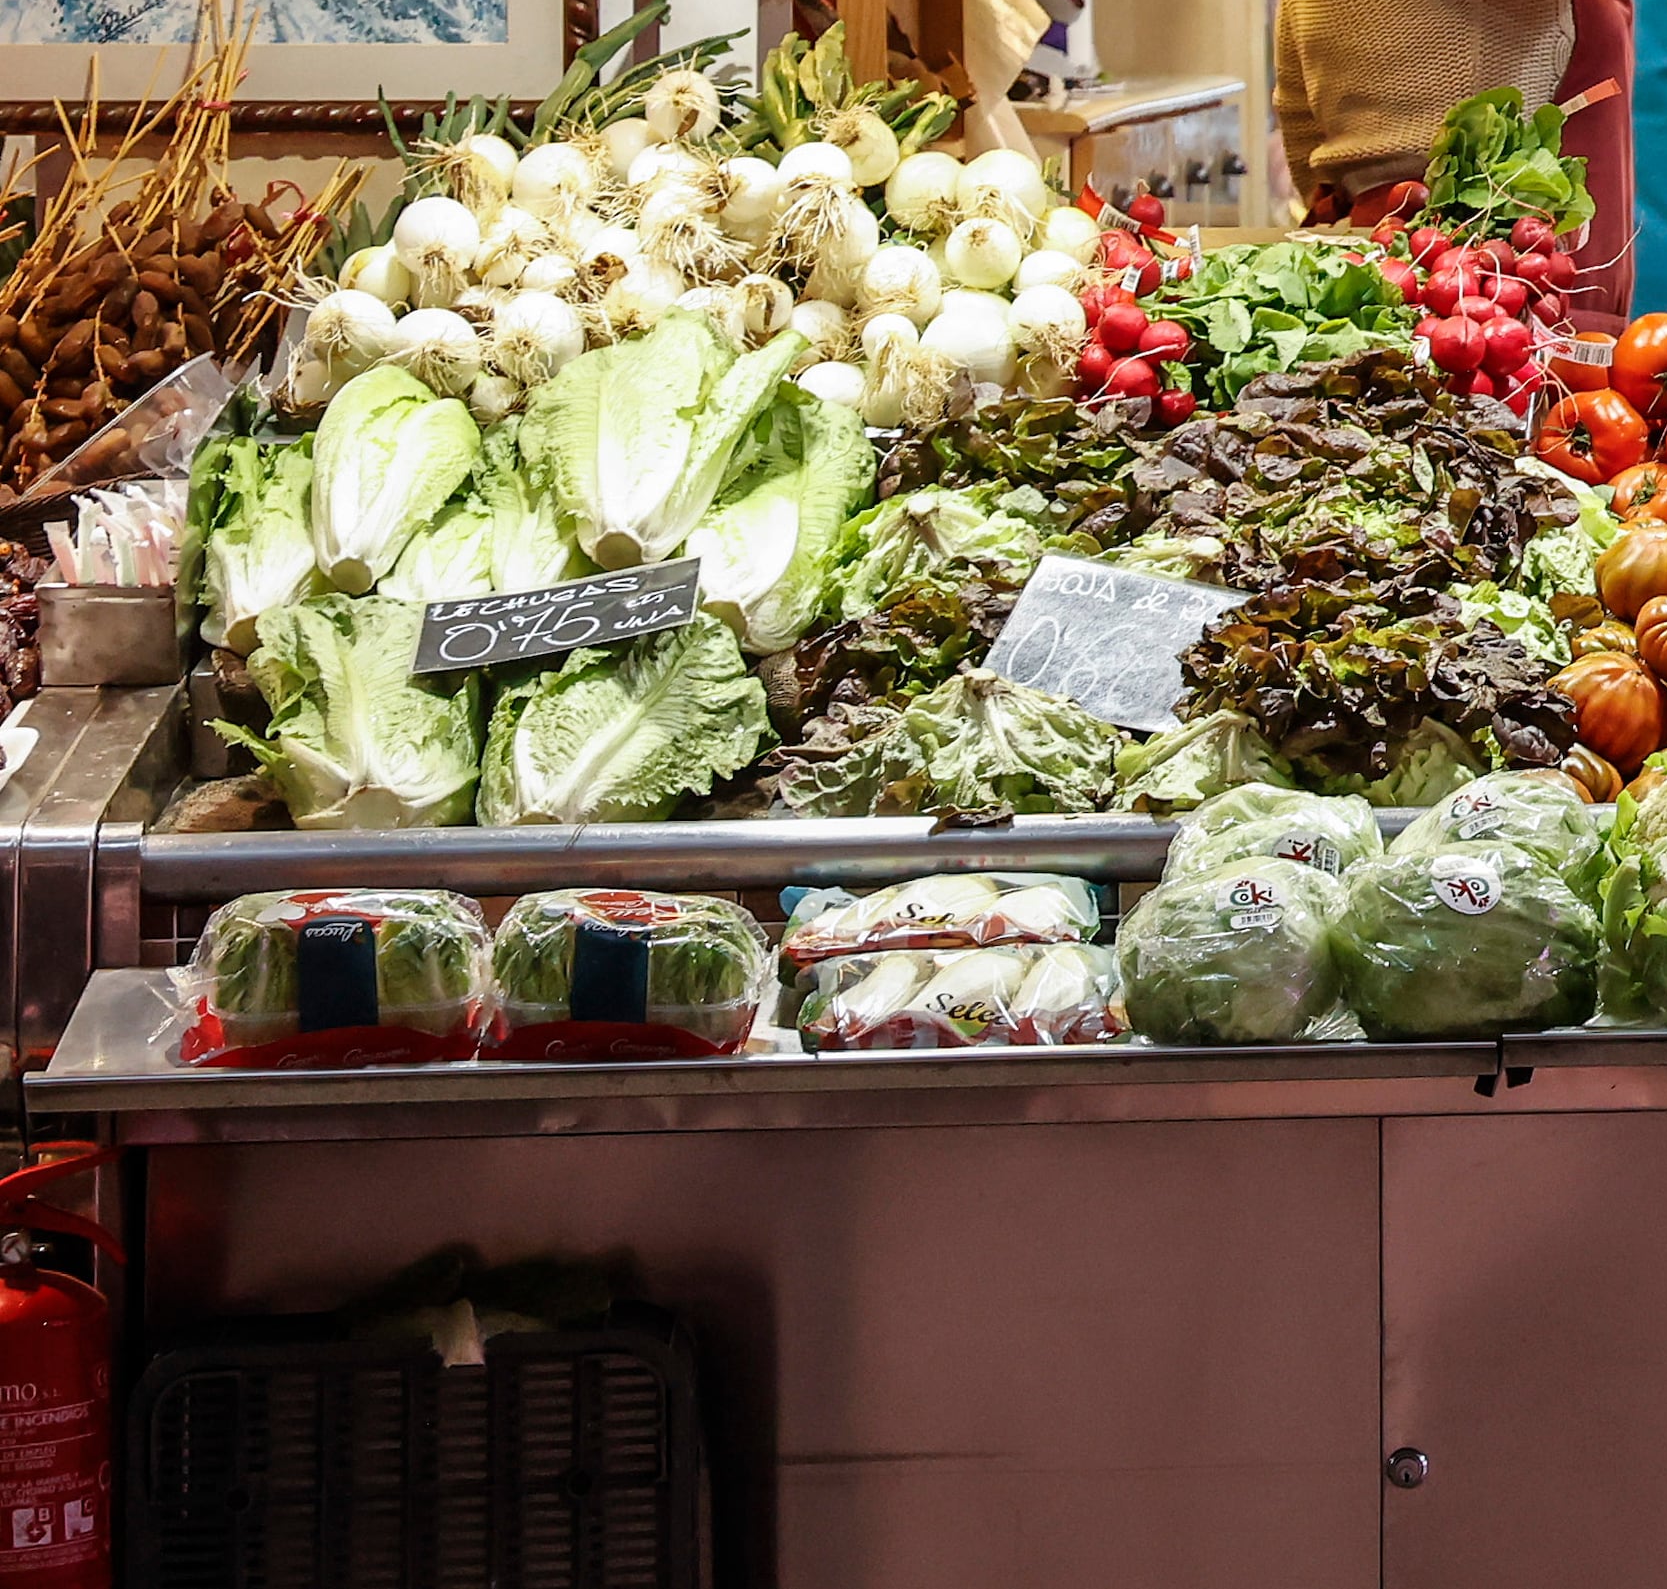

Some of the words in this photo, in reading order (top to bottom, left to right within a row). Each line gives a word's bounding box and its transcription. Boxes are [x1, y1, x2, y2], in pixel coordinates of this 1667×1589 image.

[431, 576, 639, 621] LECHUGAS
[438, 601, 600, 662] 0'75
[14, 1406, 89, 1428] INCENDIOS
